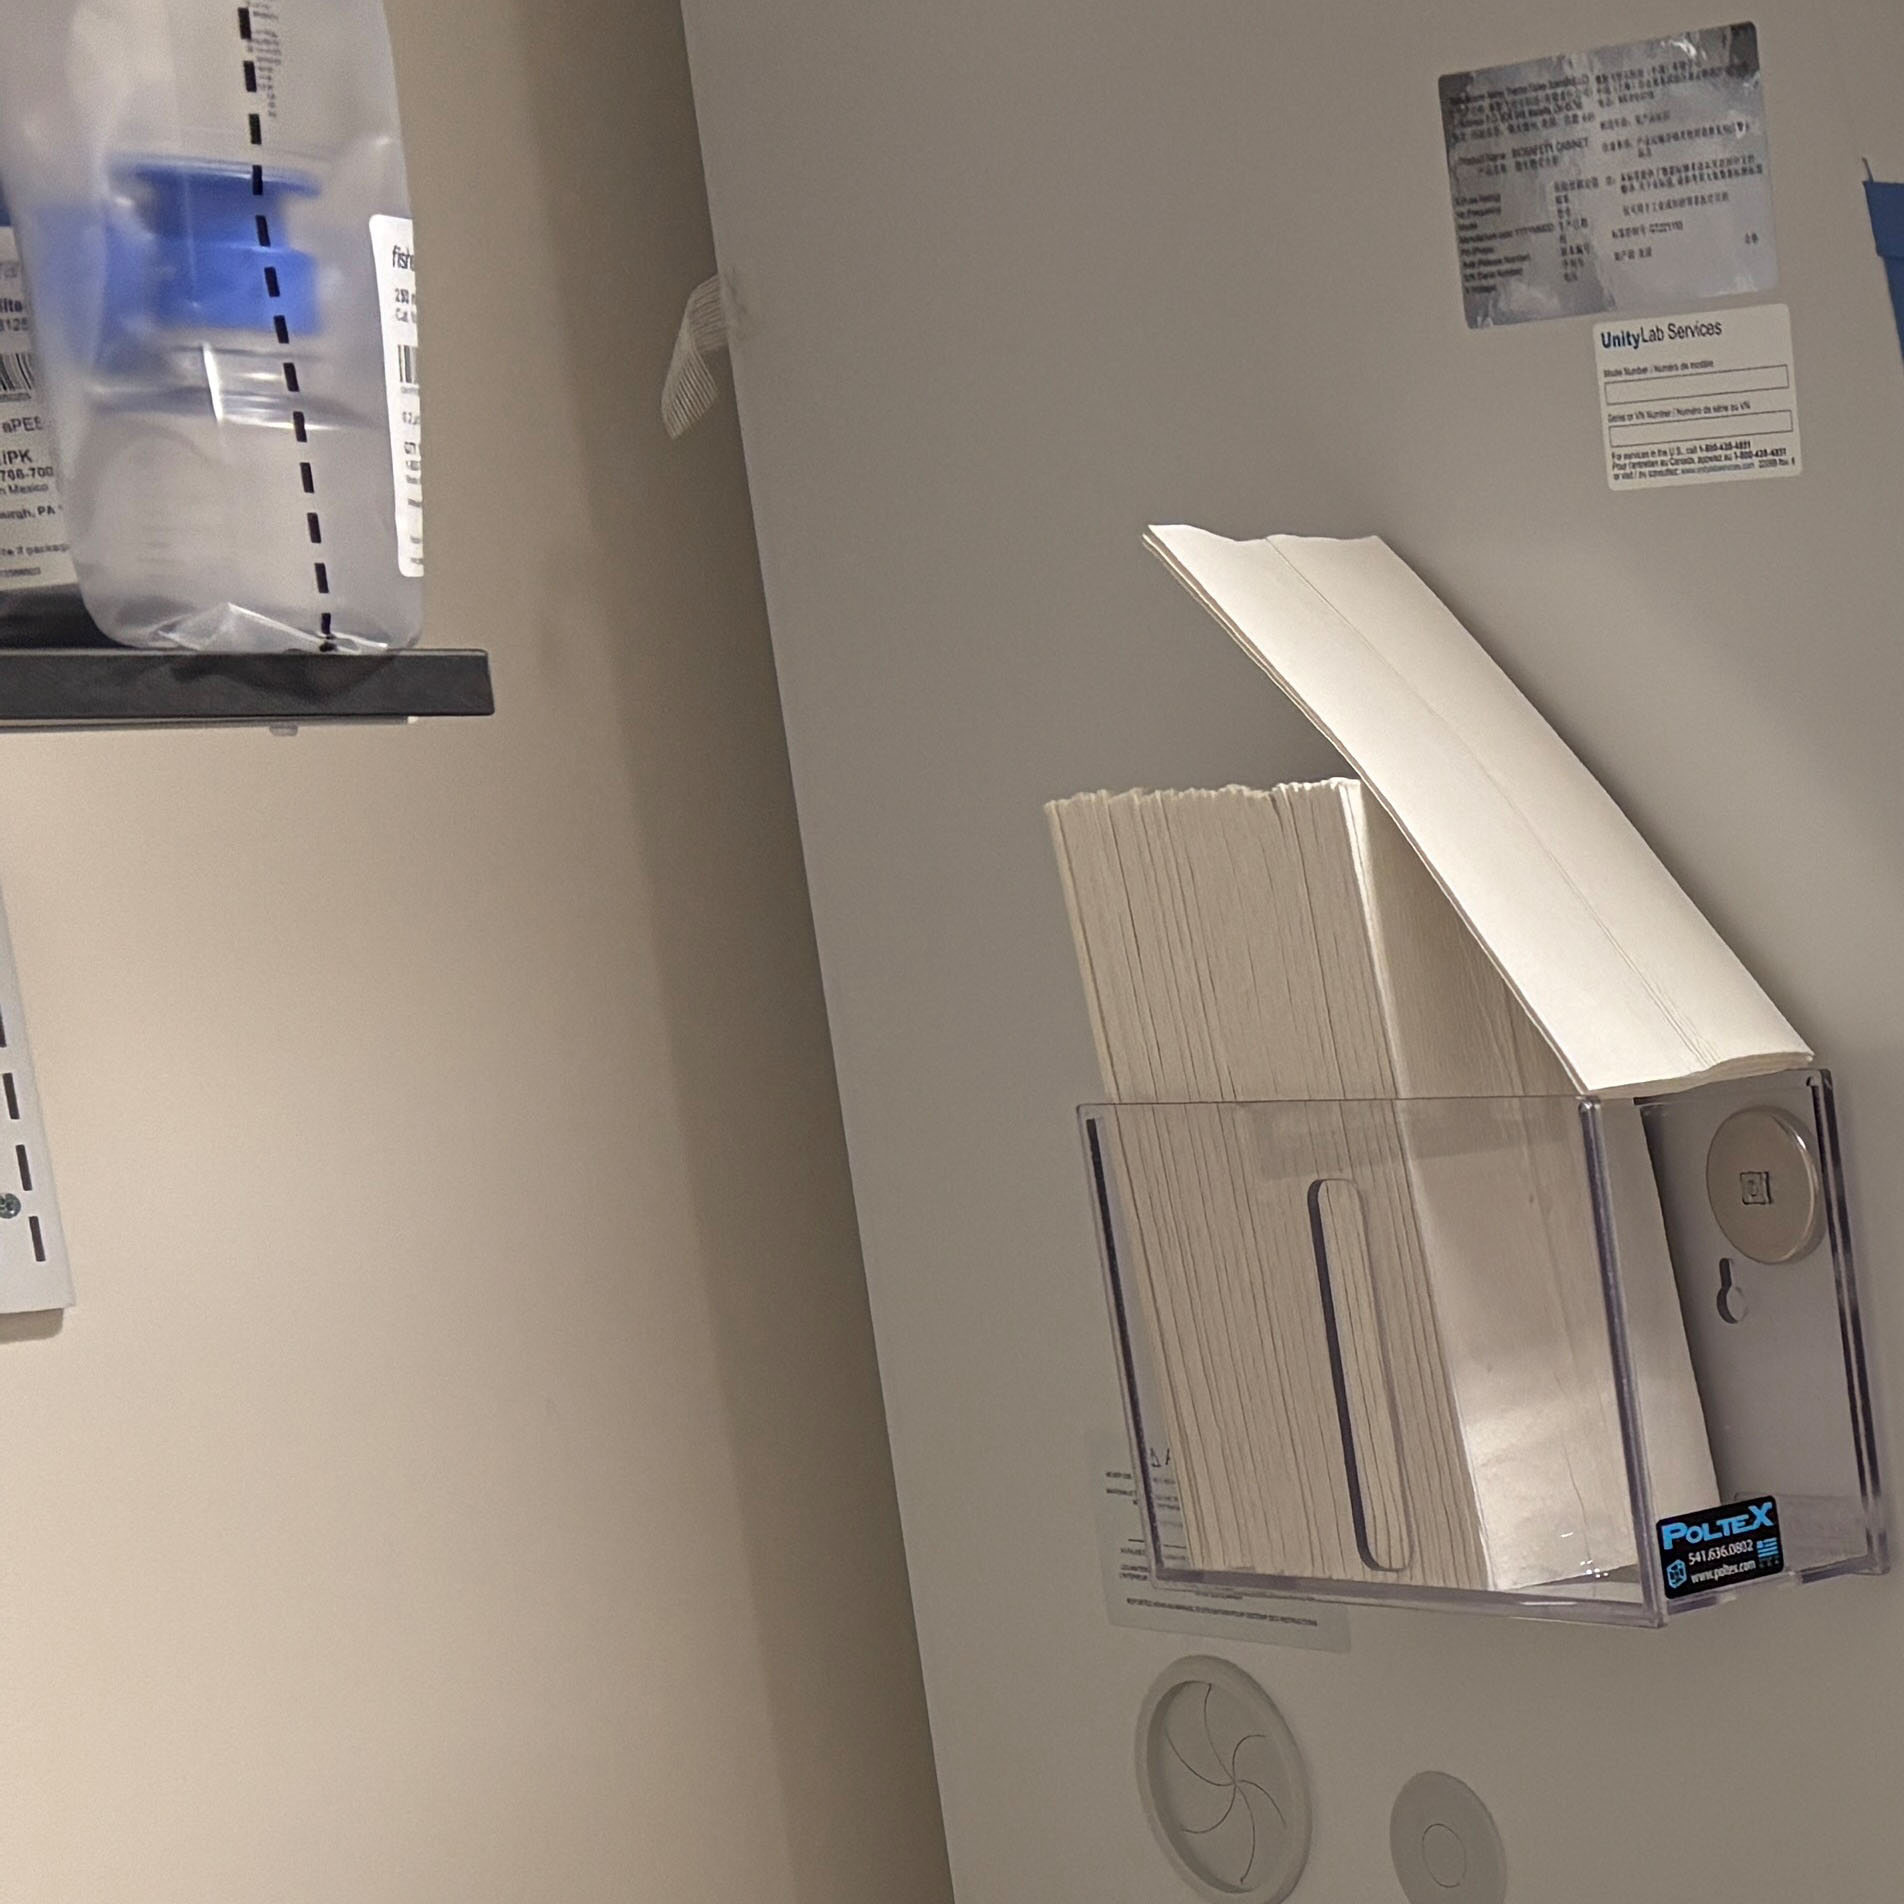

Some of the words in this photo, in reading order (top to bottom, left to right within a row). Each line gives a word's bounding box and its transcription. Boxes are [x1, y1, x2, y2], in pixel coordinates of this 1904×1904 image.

[1667, 321, 1723, 340] Services
[9, 484, 49, 495] Mexico
[37, 505, 56, 516] PA
[1691, 1560, 1757, 1584] www.poltex.com
